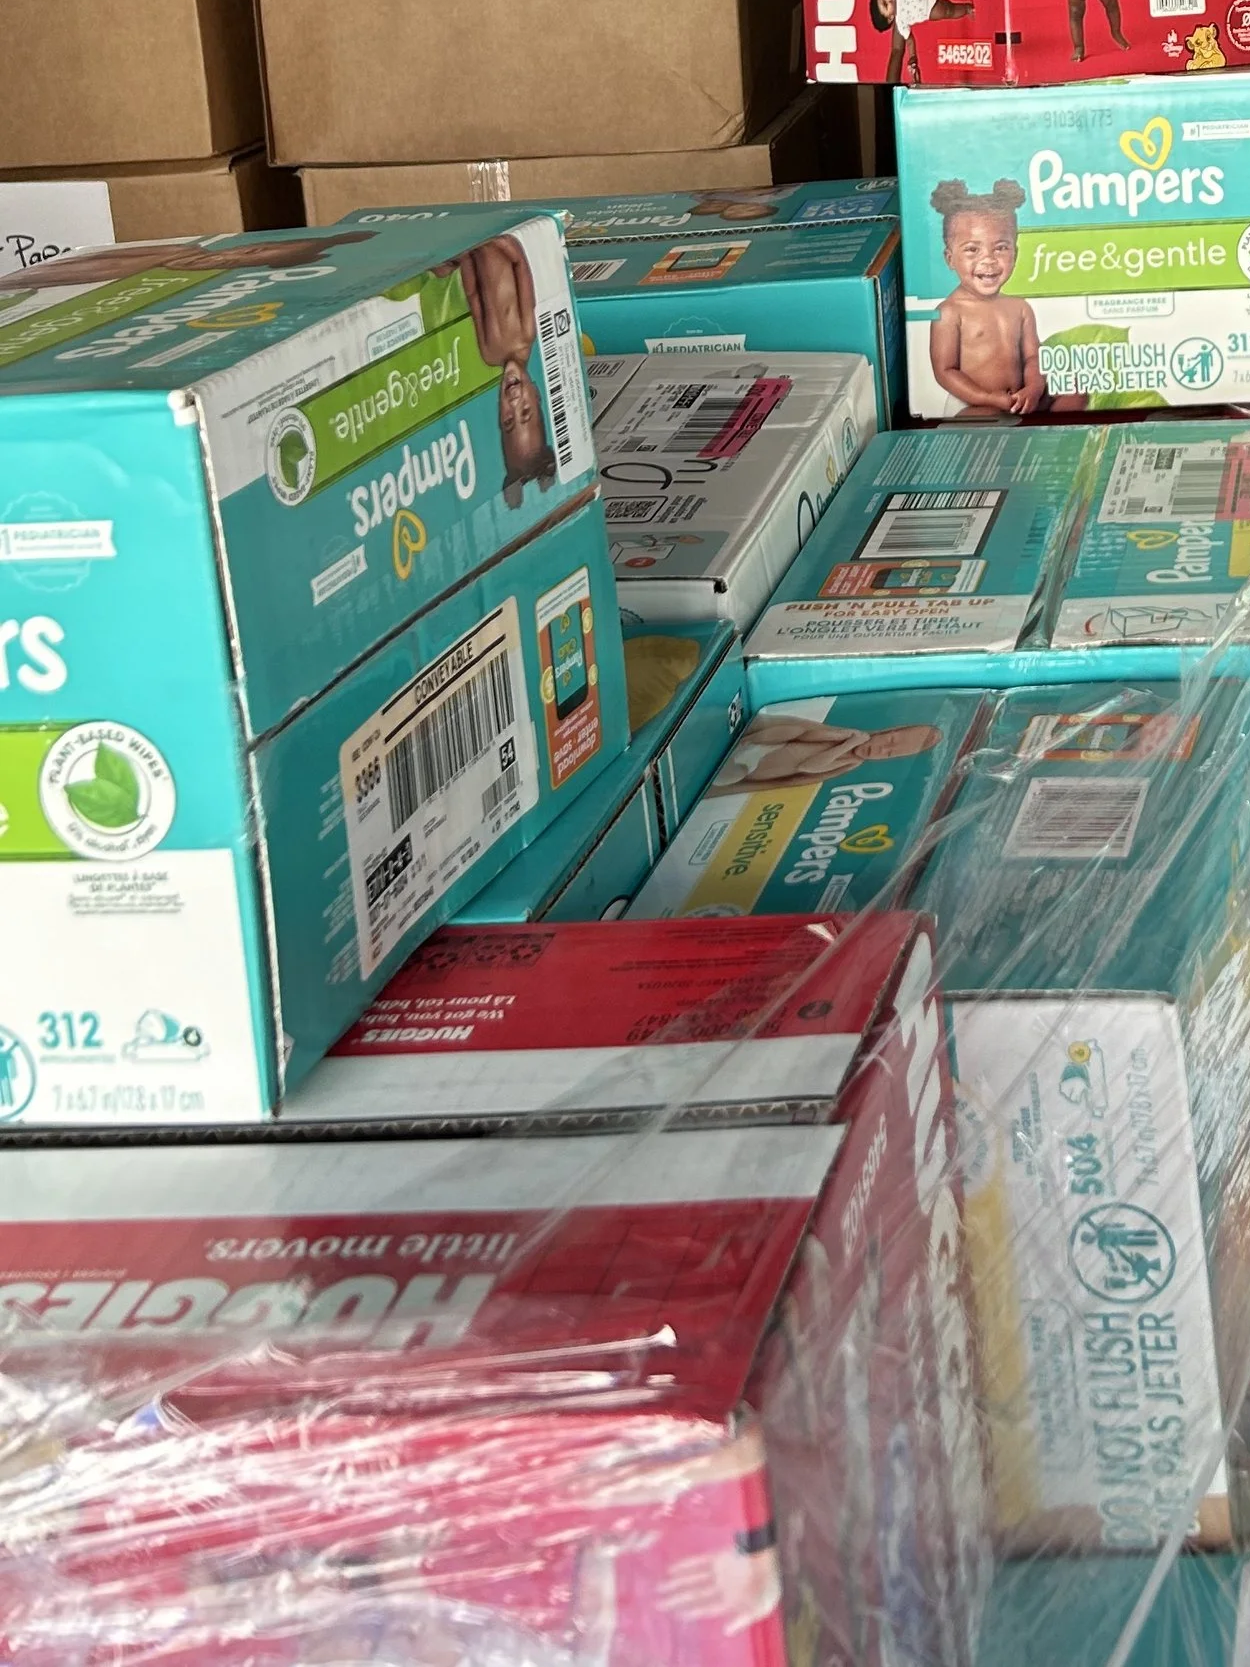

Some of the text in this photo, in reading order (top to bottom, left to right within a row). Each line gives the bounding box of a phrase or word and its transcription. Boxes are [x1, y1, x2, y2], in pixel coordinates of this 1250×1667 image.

[1028, 149, 1225, 218] Pampers
[570, 211, 692, 228] Pampe
[1028, 238, 1227, 282] free&gentle
[54, 265, 337, 361] Pampers
[1093, 297, 1167, 307] FRAGRANCE FREE
[666, 342, 741, 354] PEDIATRICIAN
[1041, 343, 1165, 372] DO NOT FLUSH
[329, 337, 461, 444] free&gentle
[1049, 371, 1167, 393] NE PAS JETER
[347, 419, 477, 537] Pampers
[785, 601, 839, 611] PUSH
[872, 599, 918, 609] PULL
[927, 599, 962, 607] TAB
[969, 598, 995, 606] UP
[824, 608, 949, 618] FOR EASY OPEN
[777, 621, 984, 635] L'ONGLET VERS LE HAUT
[806, 619, 886, 628] POUSSER
[891, 618, 909, 626] ET
[414, 641, 475, 706] CONVEYABLE
[578, 716, 599, 740] enter
[128, 738, 164, 782] WIPES
[500, 743, 516, 768] 54
[553, 739, 573, 764] save
[557, 734, 597, 779] download
[722, 802, 785, 881] sensitive
[784, 782, 894, 884] Pampers
[446, 994, 491, 1006] pour
[444, 1009, 472, 1022] got
[477, 1009, 505, 1020] We
[38, 1011, 103, 1049] 312
[360, 1025, 475, 1042] HUGGIES
[1070, 1133, 1103, 1196] 504
[206, 1233, 516, 1264] little movers
[1138, 1311, 1185, 1405] JETER
